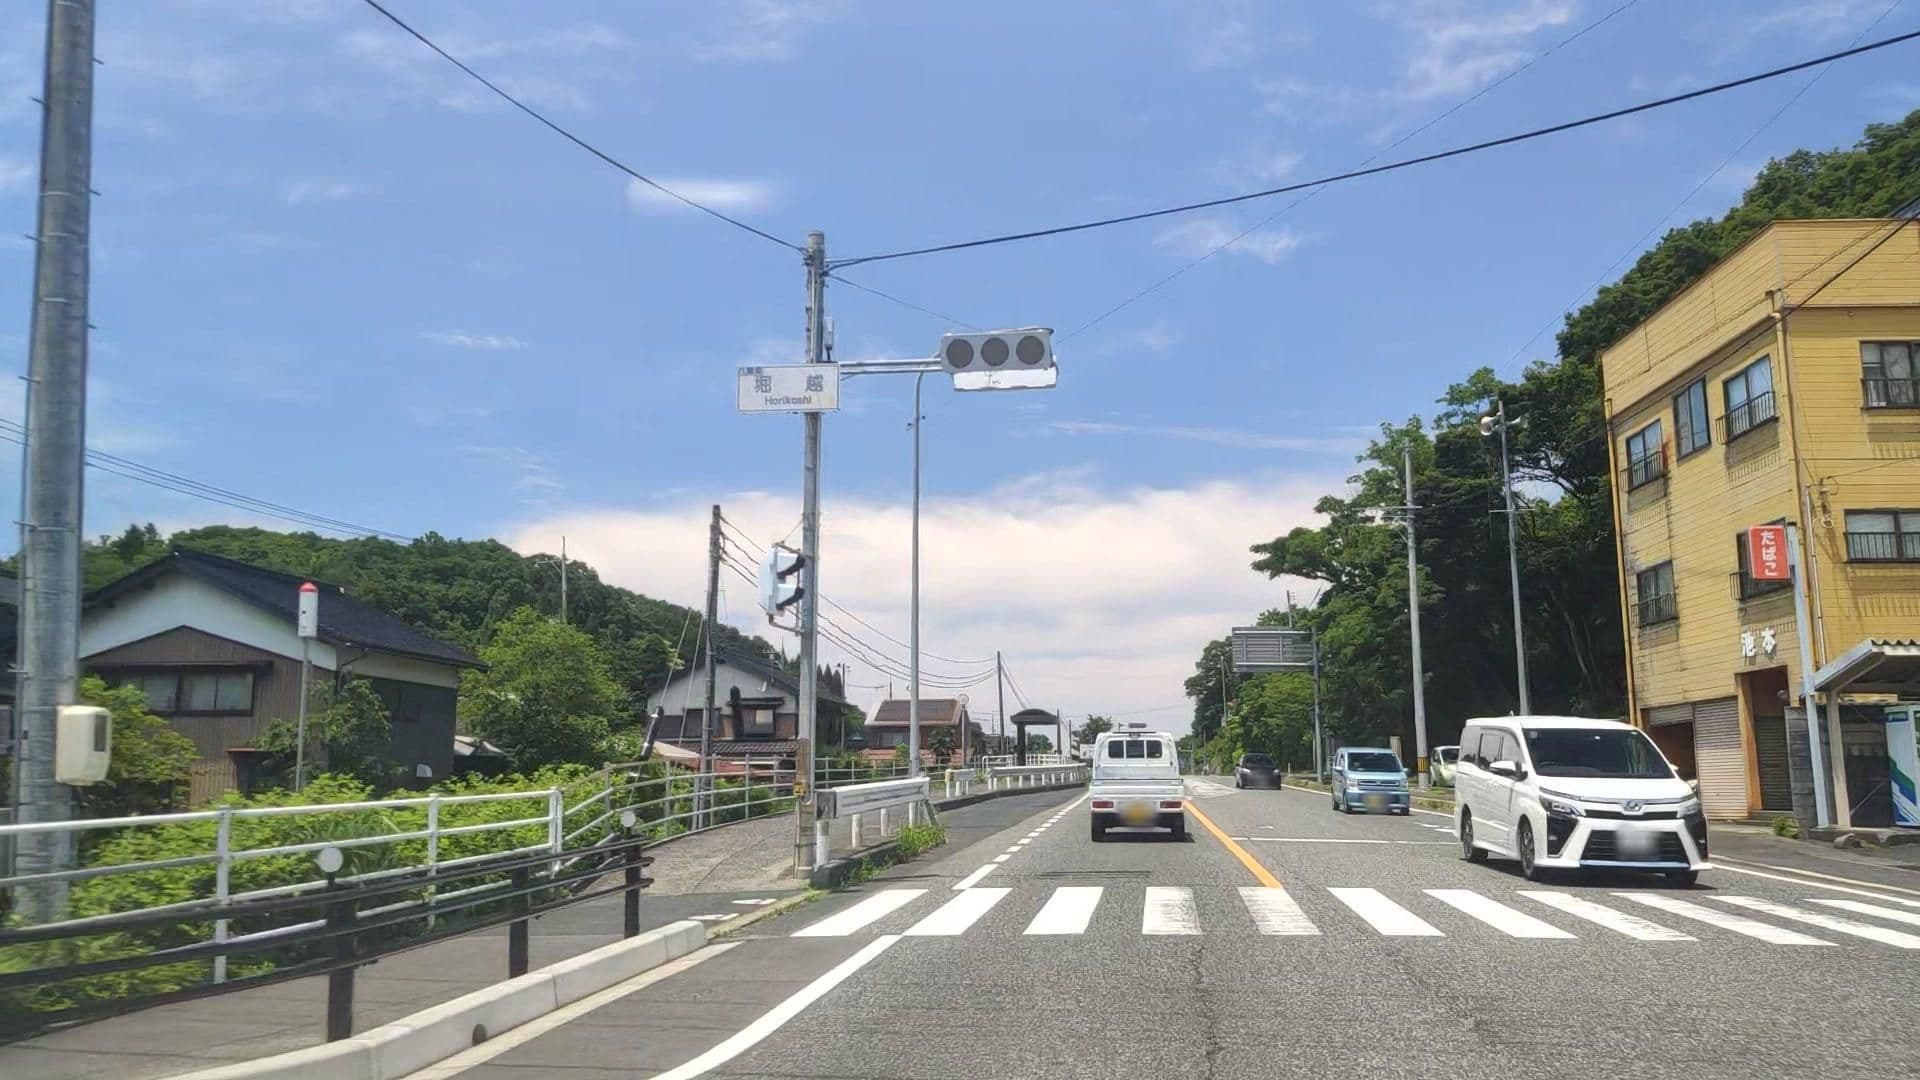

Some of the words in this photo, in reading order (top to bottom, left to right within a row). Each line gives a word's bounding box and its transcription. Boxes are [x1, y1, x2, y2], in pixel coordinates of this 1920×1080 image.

[753, 373, 824, 393] 堀越
[1760, 530, 1778, 576] たばこ
[1741, 627, 1776, 657] 池本
